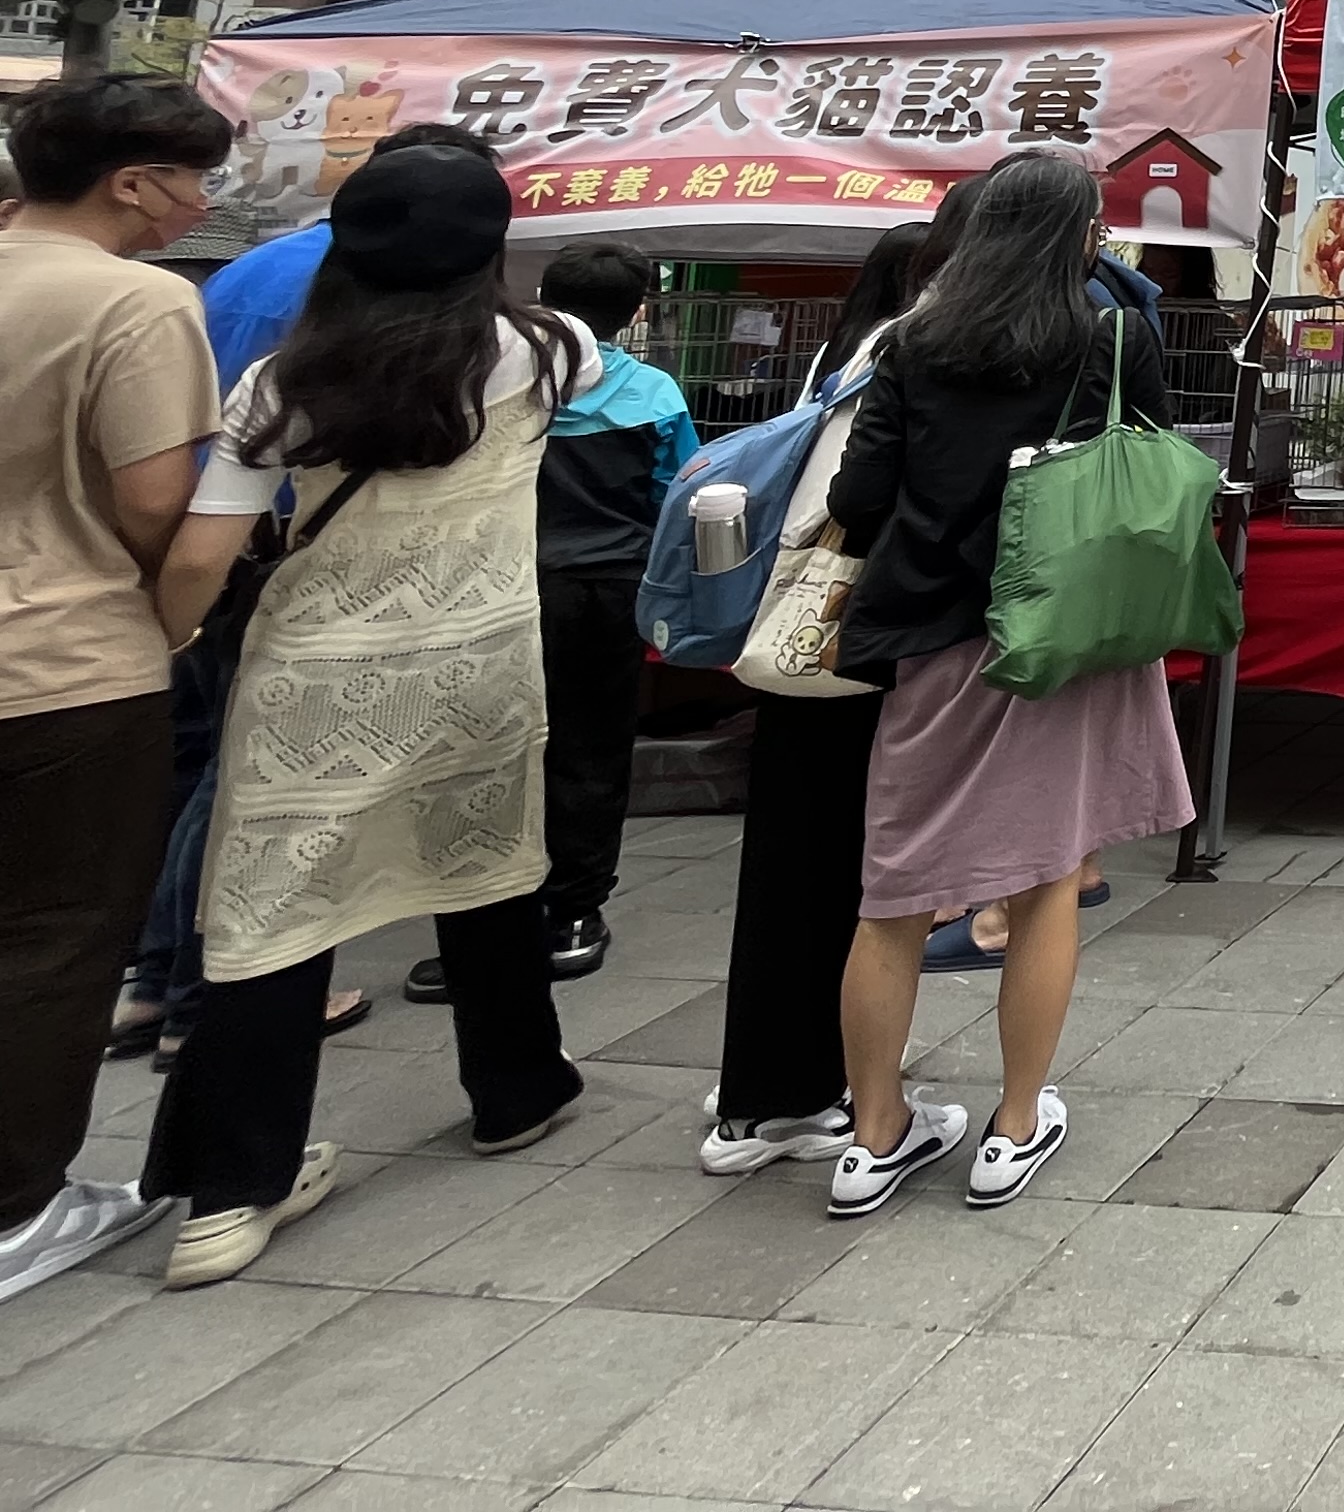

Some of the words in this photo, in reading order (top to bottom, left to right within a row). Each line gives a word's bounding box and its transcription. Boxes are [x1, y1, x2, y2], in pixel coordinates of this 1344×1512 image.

[453, 53, 1106, 144] 免費犬貓認養
